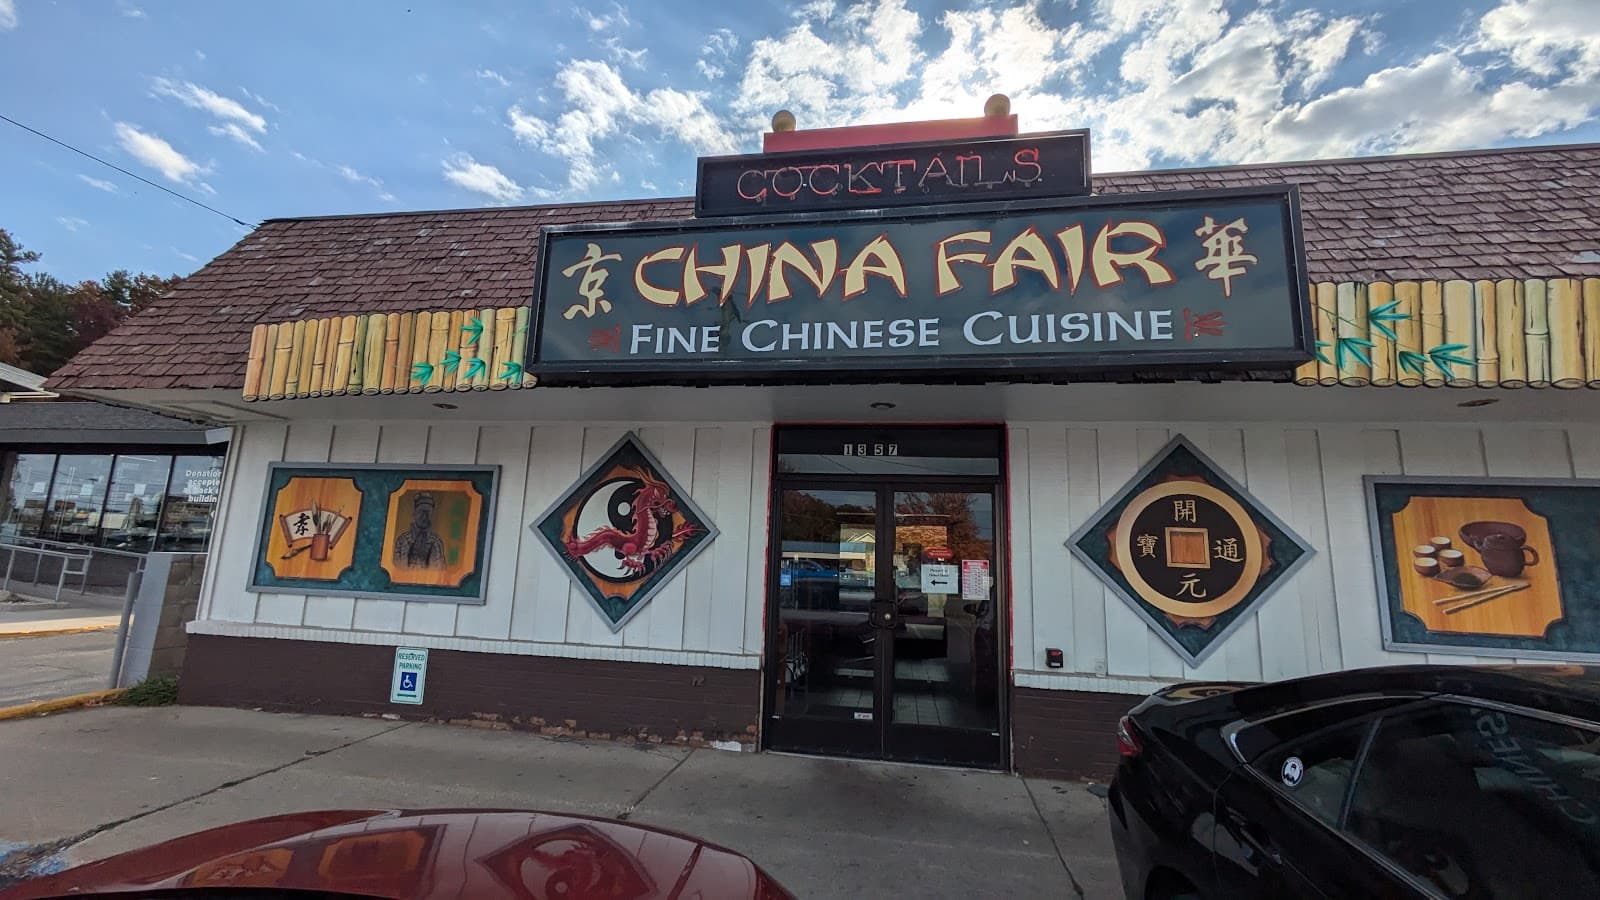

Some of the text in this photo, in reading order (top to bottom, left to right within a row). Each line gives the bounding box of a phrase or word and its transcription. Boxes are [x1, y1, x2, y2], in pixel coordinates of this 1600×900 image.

[737, 149, 1042, 200] COCKTAILS
[633, 219, 1177, 311] CHINA FAIR
[1194, 215, 1258, 298] 華
[561, 242, 623, 320] 京
[630, 309, 1174, 354] FINE CHINESE CUISINE
[844, 444, 897, 456] 1357
[1173, 500, 1197, 524] 開
[1213, 537, 1243, 563] 通
[1176, 572, 1207, 599] 元
[398, 652, 425, 661] RESERVED
[398, 662, 422, 671] PARKING
